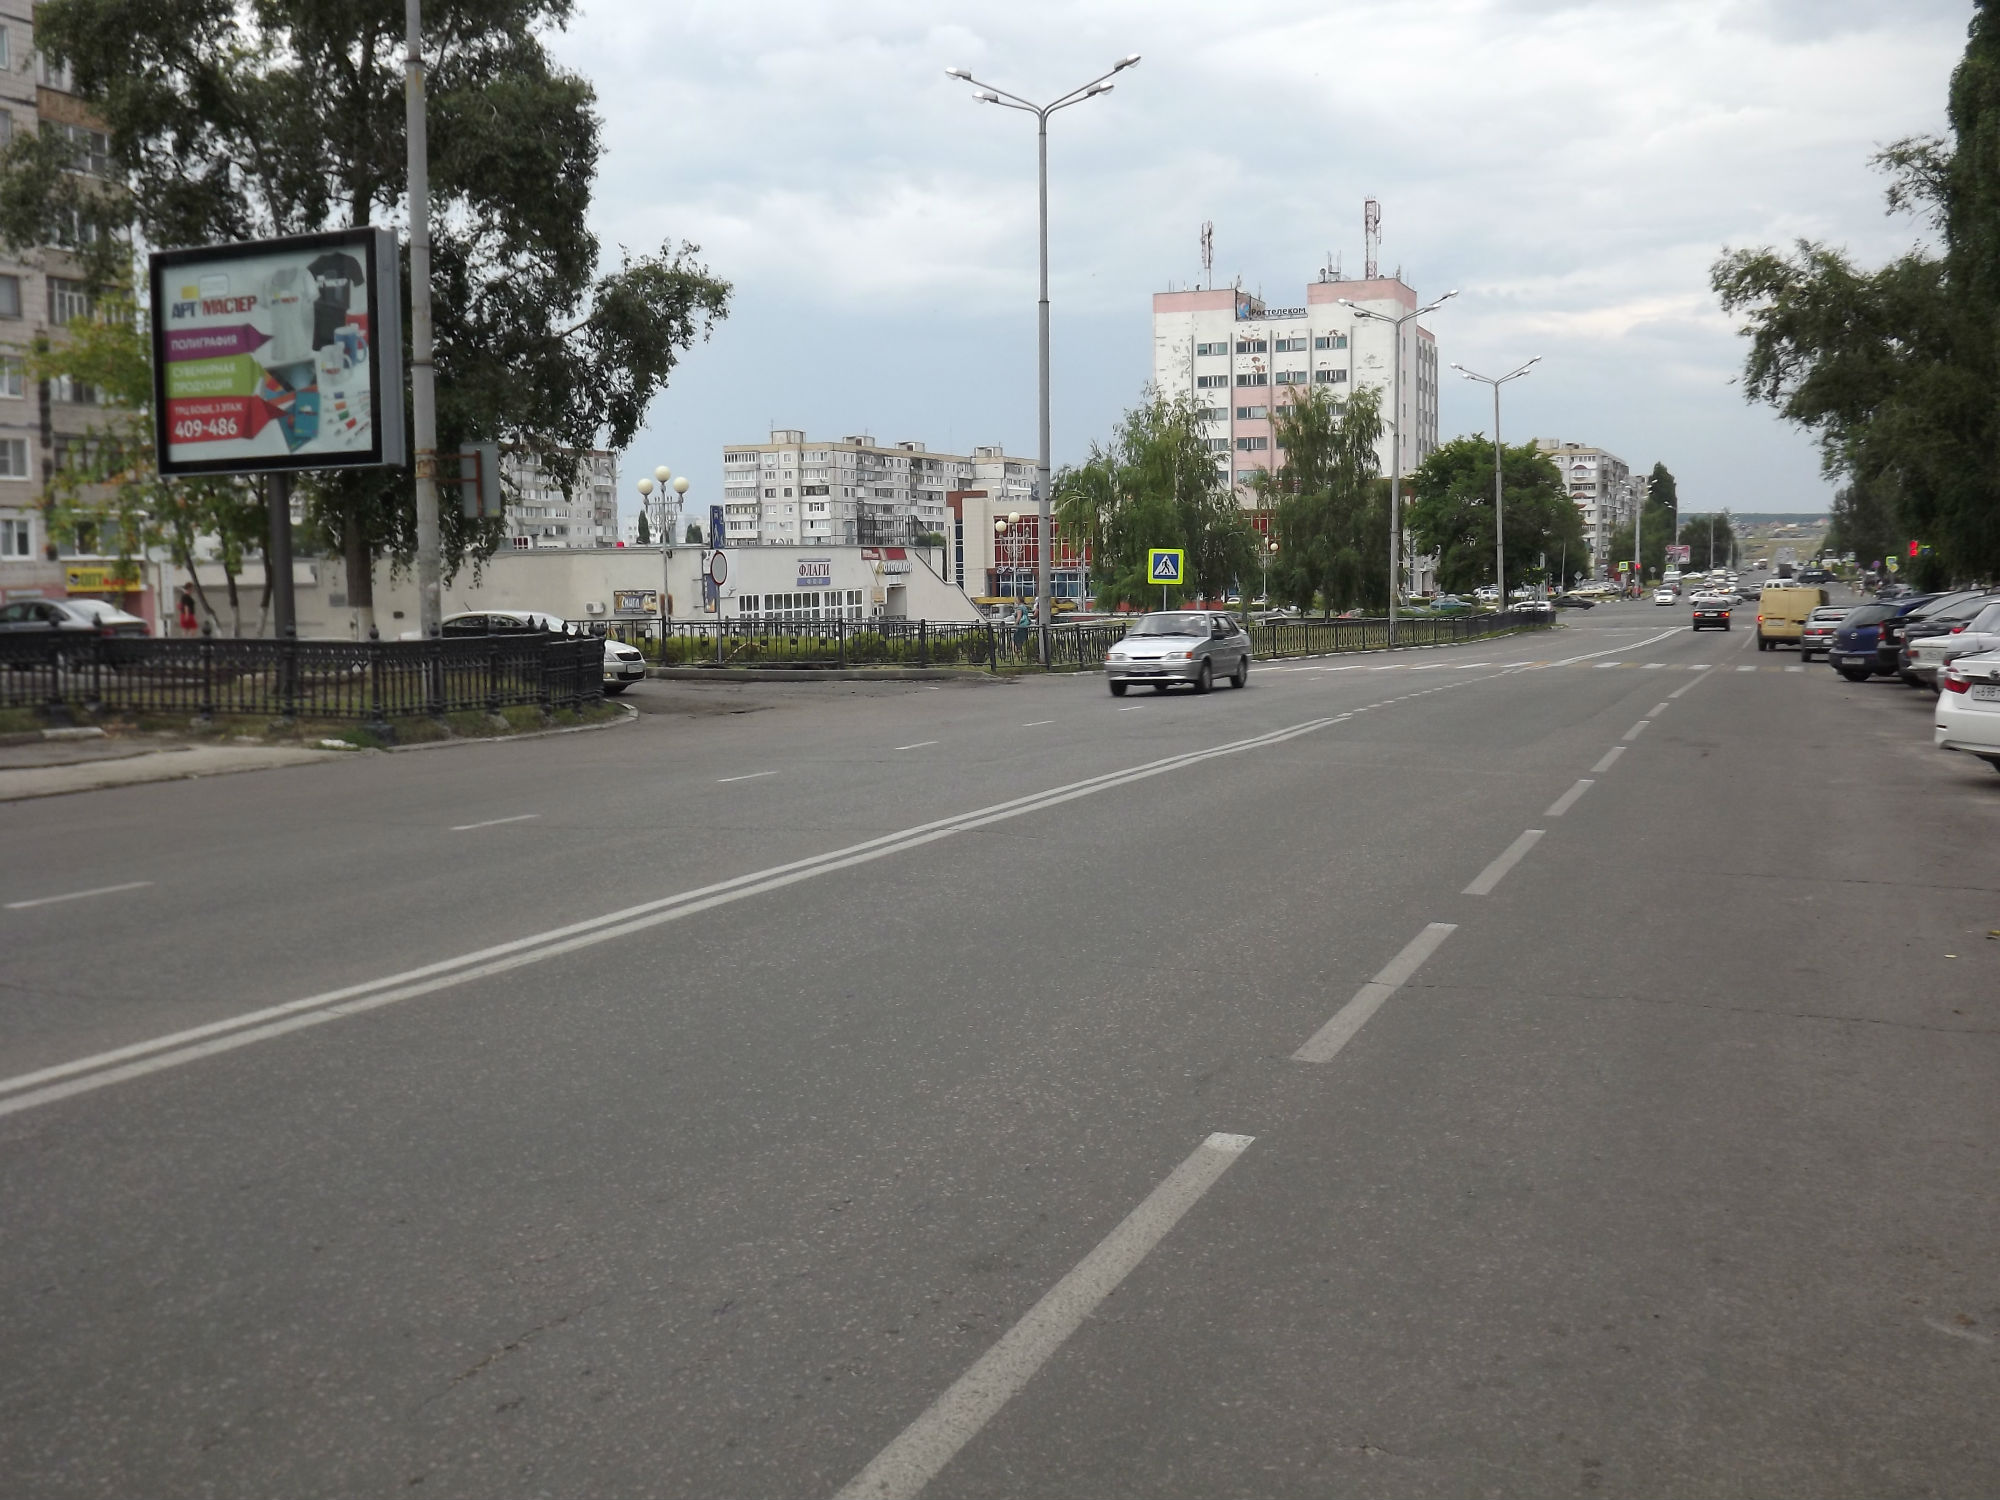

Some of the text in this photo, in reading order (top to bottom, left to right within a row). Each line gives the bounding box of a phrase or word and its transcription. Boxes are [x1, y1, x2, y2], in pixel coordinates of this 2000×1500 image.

[171, 301, 197, 319] АРТ
[202, 295, 258, 316] МАСТЕР
[1251, 307, 1306, 317] Ростелеком
[171, 334, 238, 351] ПОЛИГРАФИЯ
[172, 362, 236, 378] СУВЕНИРНАЯ
[173, 378, 233, 393] ПРОДУКЦИЯ
[174, 417, 238, 438] 409-486
[798, 563, 830, 576] ФЛАГИ
